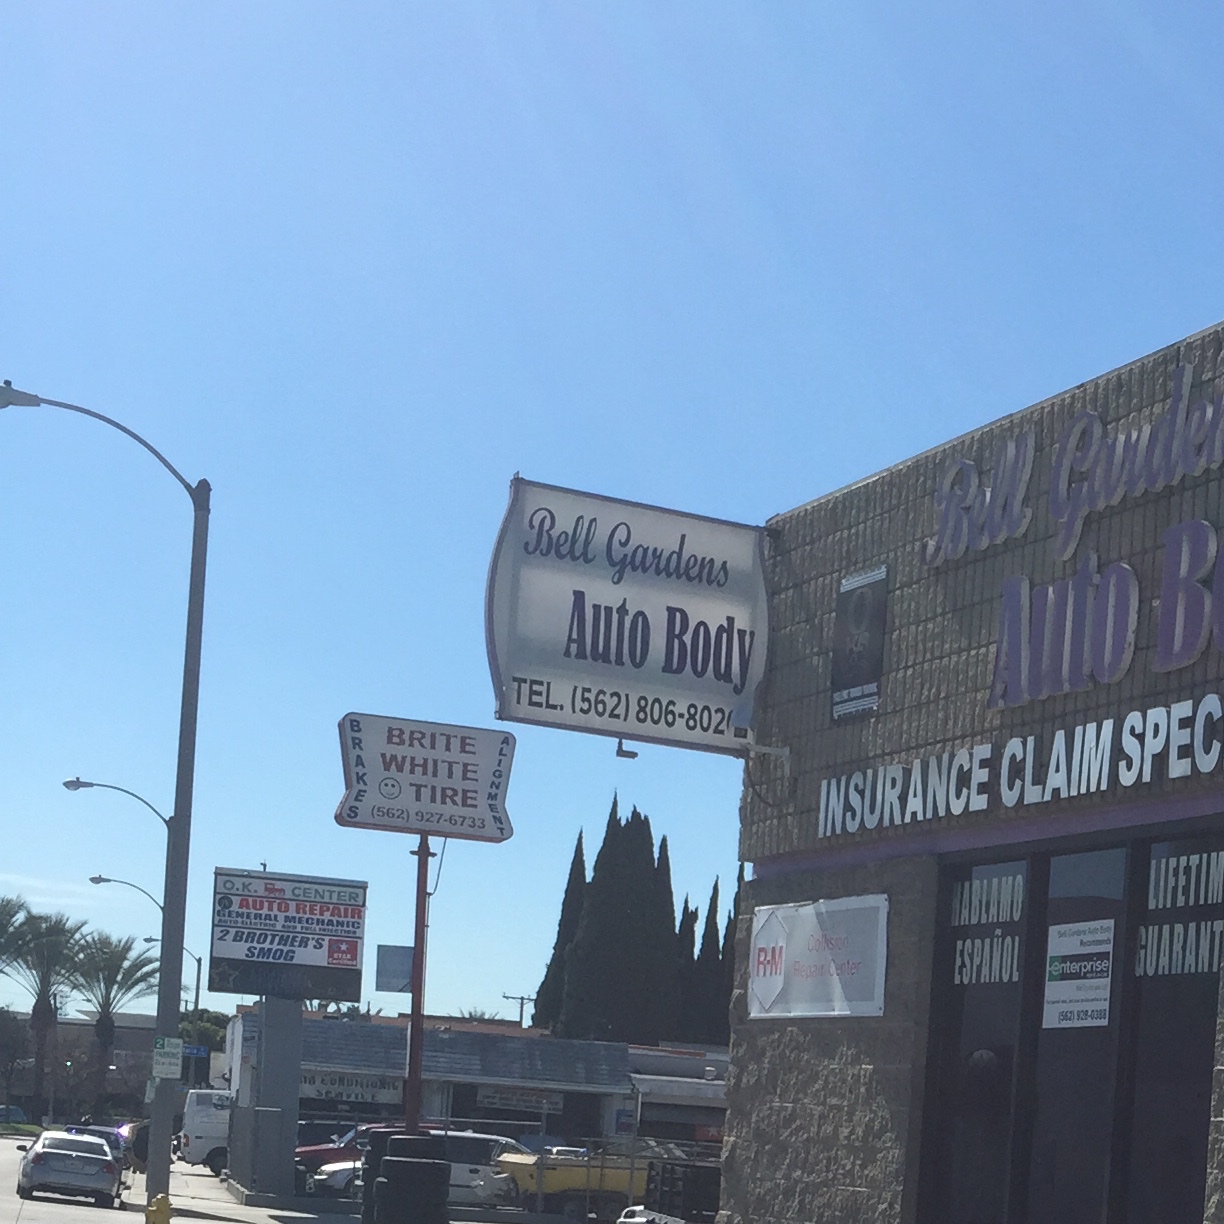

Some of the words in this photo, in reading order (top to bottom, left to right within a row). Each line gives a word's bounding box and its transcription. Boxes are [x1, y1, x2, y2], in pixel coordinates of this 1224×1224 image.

[922, 430, 1037, 568] Bell
[523, 506, 598, 564] Bell
[605, 521, 730, 588] Gardens
[563, 589, 651, 669] Auto
[661, 604, 755, 695] Body
[986, 552, 1140, 712] Auto
[512, 676, 564, 711] TEL.
[571, 685, 631, 722] (562)
[386, 726, 477, 755] BRITE
[346, 719, 368, 819] BRAKES
[380, 752, 479, 783] WHITE
[818, 744, 992, 838] INSURANCE
[1000, 719, 1113, 808] CLAIM
[409, 782, 479, 809] TIRE
[487, 736, 510, 837] ALIGNMENT
[371, 805, 410, 822] (562)
[415, 811, 486, 830] 927-6733
[223, 879, 258, 894] O.K.
[291, 886, 360, 903] CENTER
[951, 874, 1024, 927] HABLAMO
[216, 909, 279, 923] GENERAL
[284, 915, 361, 930] MECHANIC
[238, 898, 290, 913] AUTO
[295, 902, 363, 920] REPAIR
[217, 929, 230, 942] 2
[232, 930, 326, 950] BROTHER'S
[245, 946, 296, 963] SMOG
[808, 933, 849, 953] Collision
[1135, 919, 1223, 977] GUARANT
[793, 960, 825, 981] Repair
[828, 957, 861, 977] Center
[954, 928, 1020, 985] ESPAÑOL
[1048, 957, 1109, 976] enterprise
